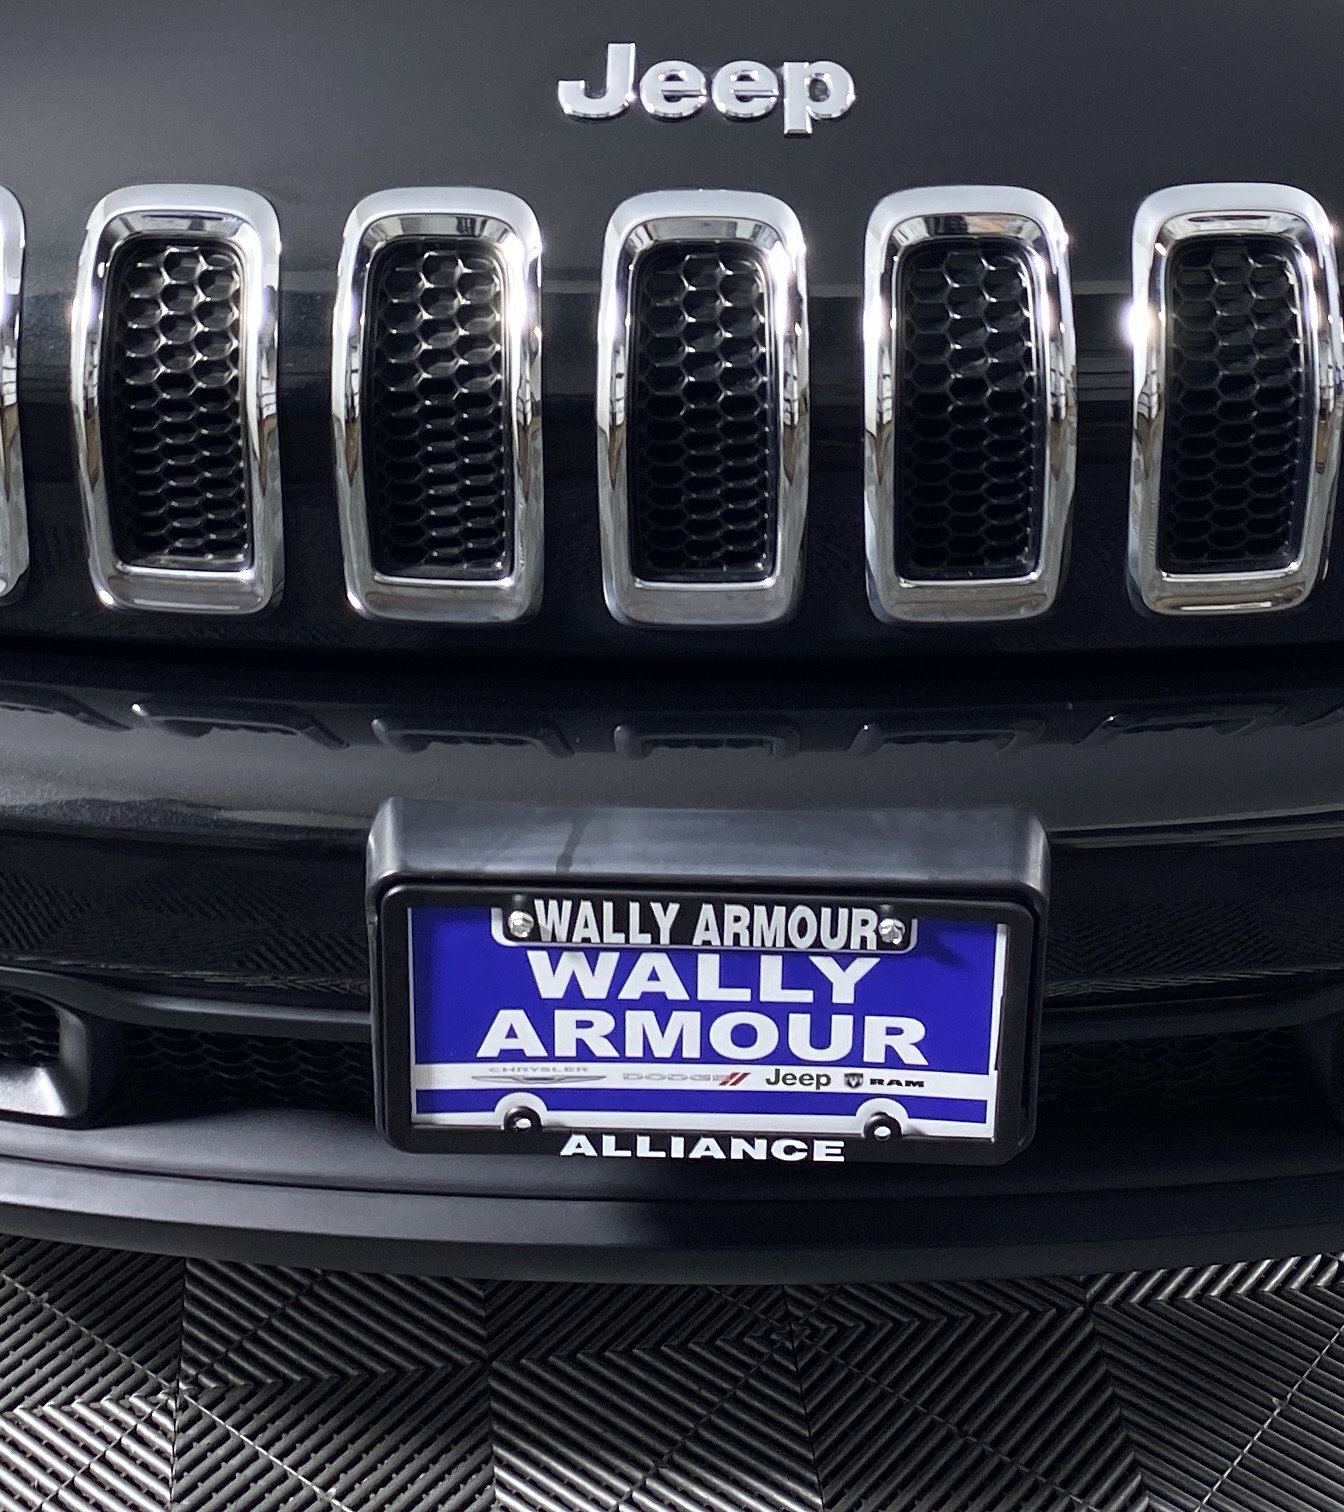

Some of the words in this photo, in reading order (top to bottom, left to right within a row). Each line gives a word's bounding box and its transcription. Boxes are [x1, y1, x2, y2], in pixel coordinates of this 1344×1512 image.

[557, 42, 856, 138] Jeep
[534, 899, 680, 946] WALLY
[692, 903, 878, 950] ARMOUR
[527, 951, 881, 1004] WALLY
[476, 1009, 929, 1066] ARMOUR
[488, 1065, 589, 1074] CHRYSLER
[765, 1068, 832, 1090] Jeep
[869, 1077, 925, 1088] RAM
[559, 1133, 845, 1163] ALLIANCE
